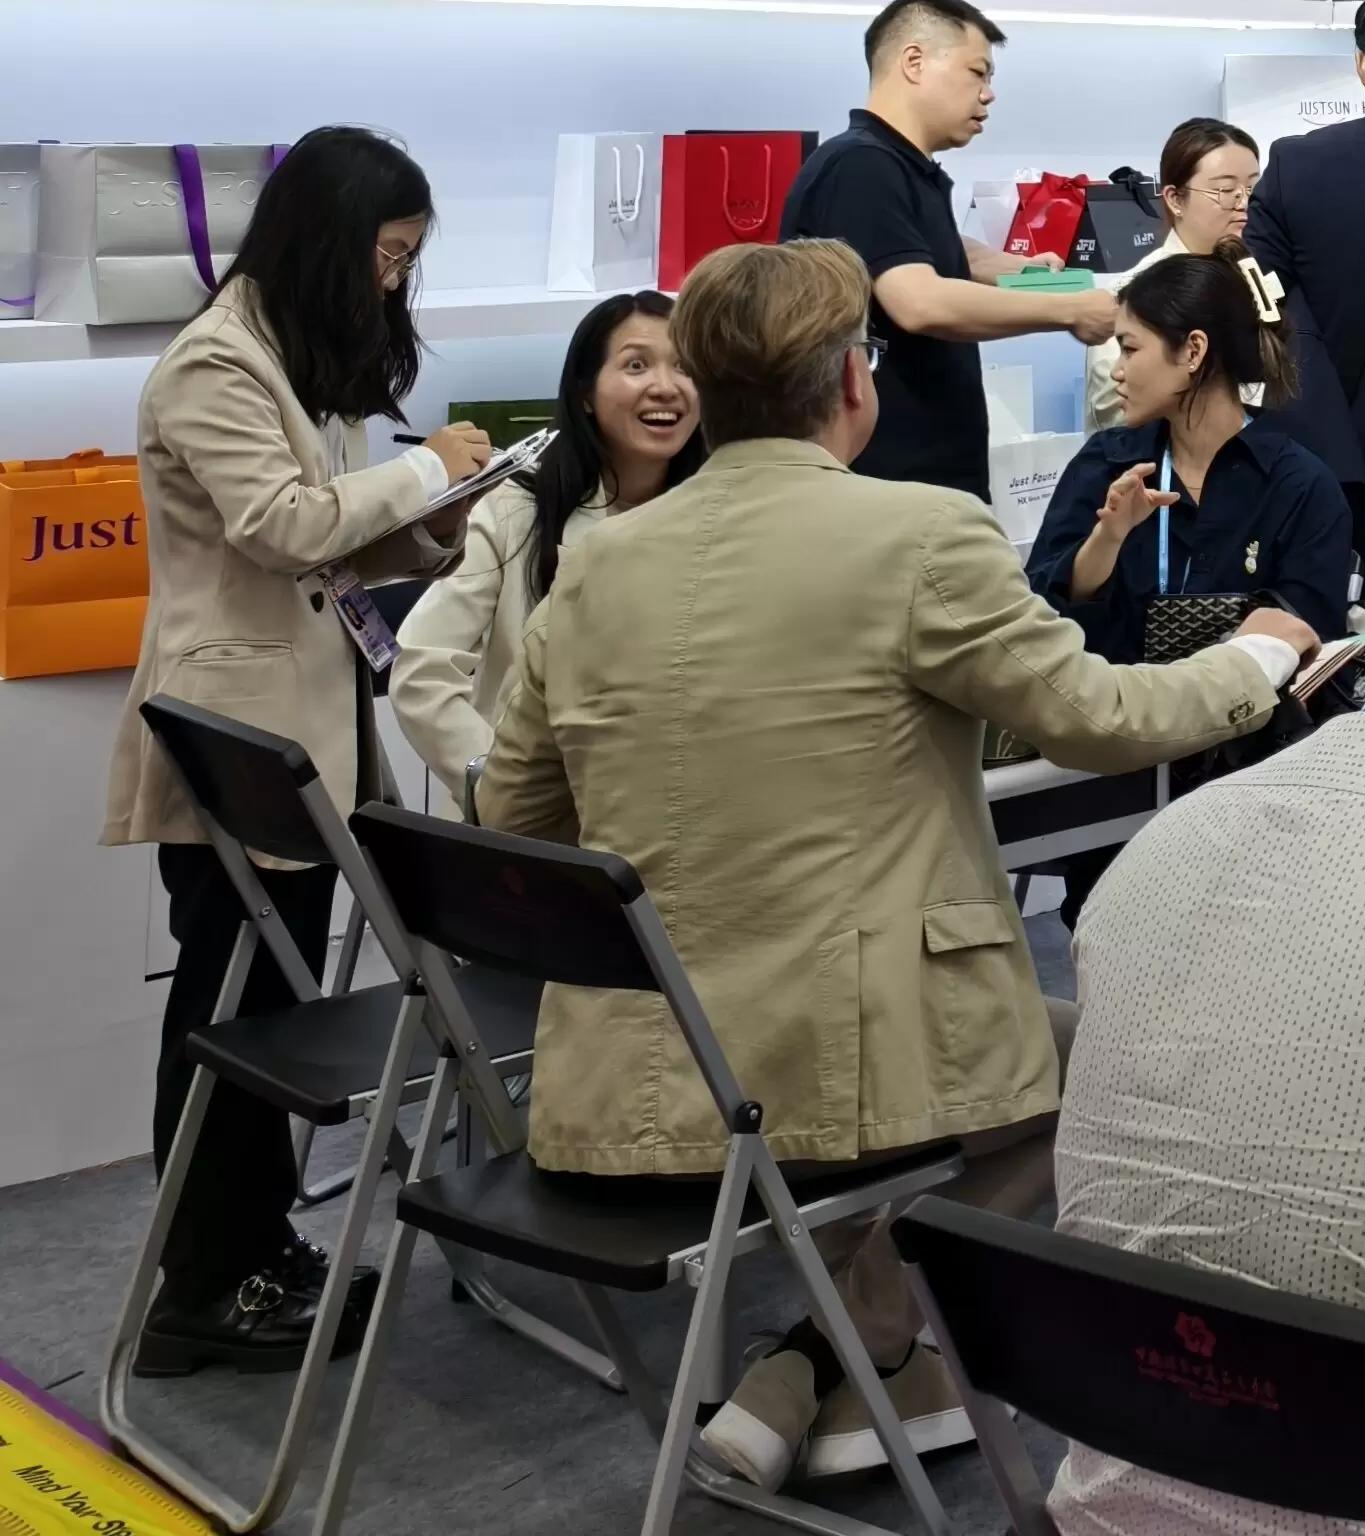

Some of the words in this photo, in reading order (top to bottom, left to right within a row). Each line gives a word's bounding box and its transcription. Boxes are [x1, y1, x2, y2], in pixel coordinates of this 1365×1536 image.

[1298, 101, 1351, 116] JUSTSUN
[1009, 477, 1029, 488] Just
[1032, 470, 1057, 483] Found
[22, 511, 142, 562] Just
[12, 1464, 73, 1494] Mind
[54, 1490, 104, 1519] Your
